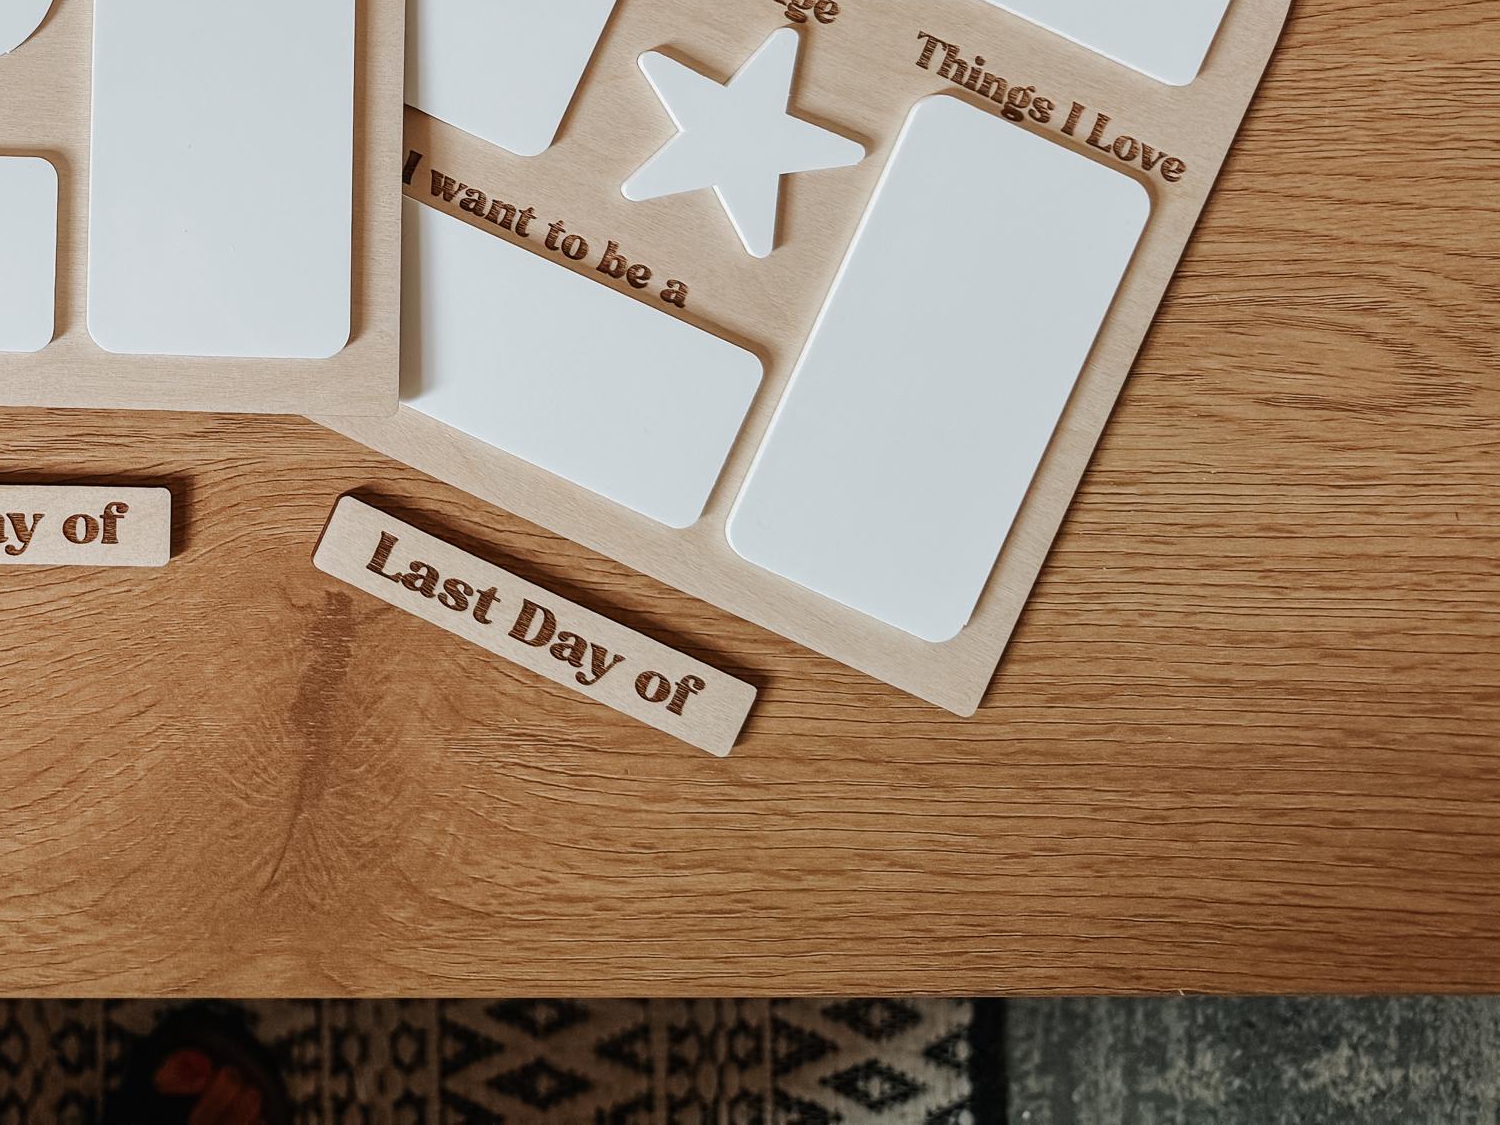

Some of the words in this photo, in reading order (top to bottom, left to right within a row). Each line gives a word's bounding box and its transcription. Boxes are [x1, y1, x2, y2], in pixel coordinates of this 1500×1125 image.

[915, 30, 1054, 125] Things
[1067, 101, 1087, 137] I
[1088, 113, 1188, 184] Love
[402, 149, 423, 185] I
[430, 168, 537, 238] want
[544, 219, 590, 261] to
[595, 238, 653, 289] be
[659, 278, 690, 309] a
[62, 501, 130, 546] of
[365, 530, 502, 626] Last
[507, 597, 626, 686] Day
[634, 669, 706, 717] of
